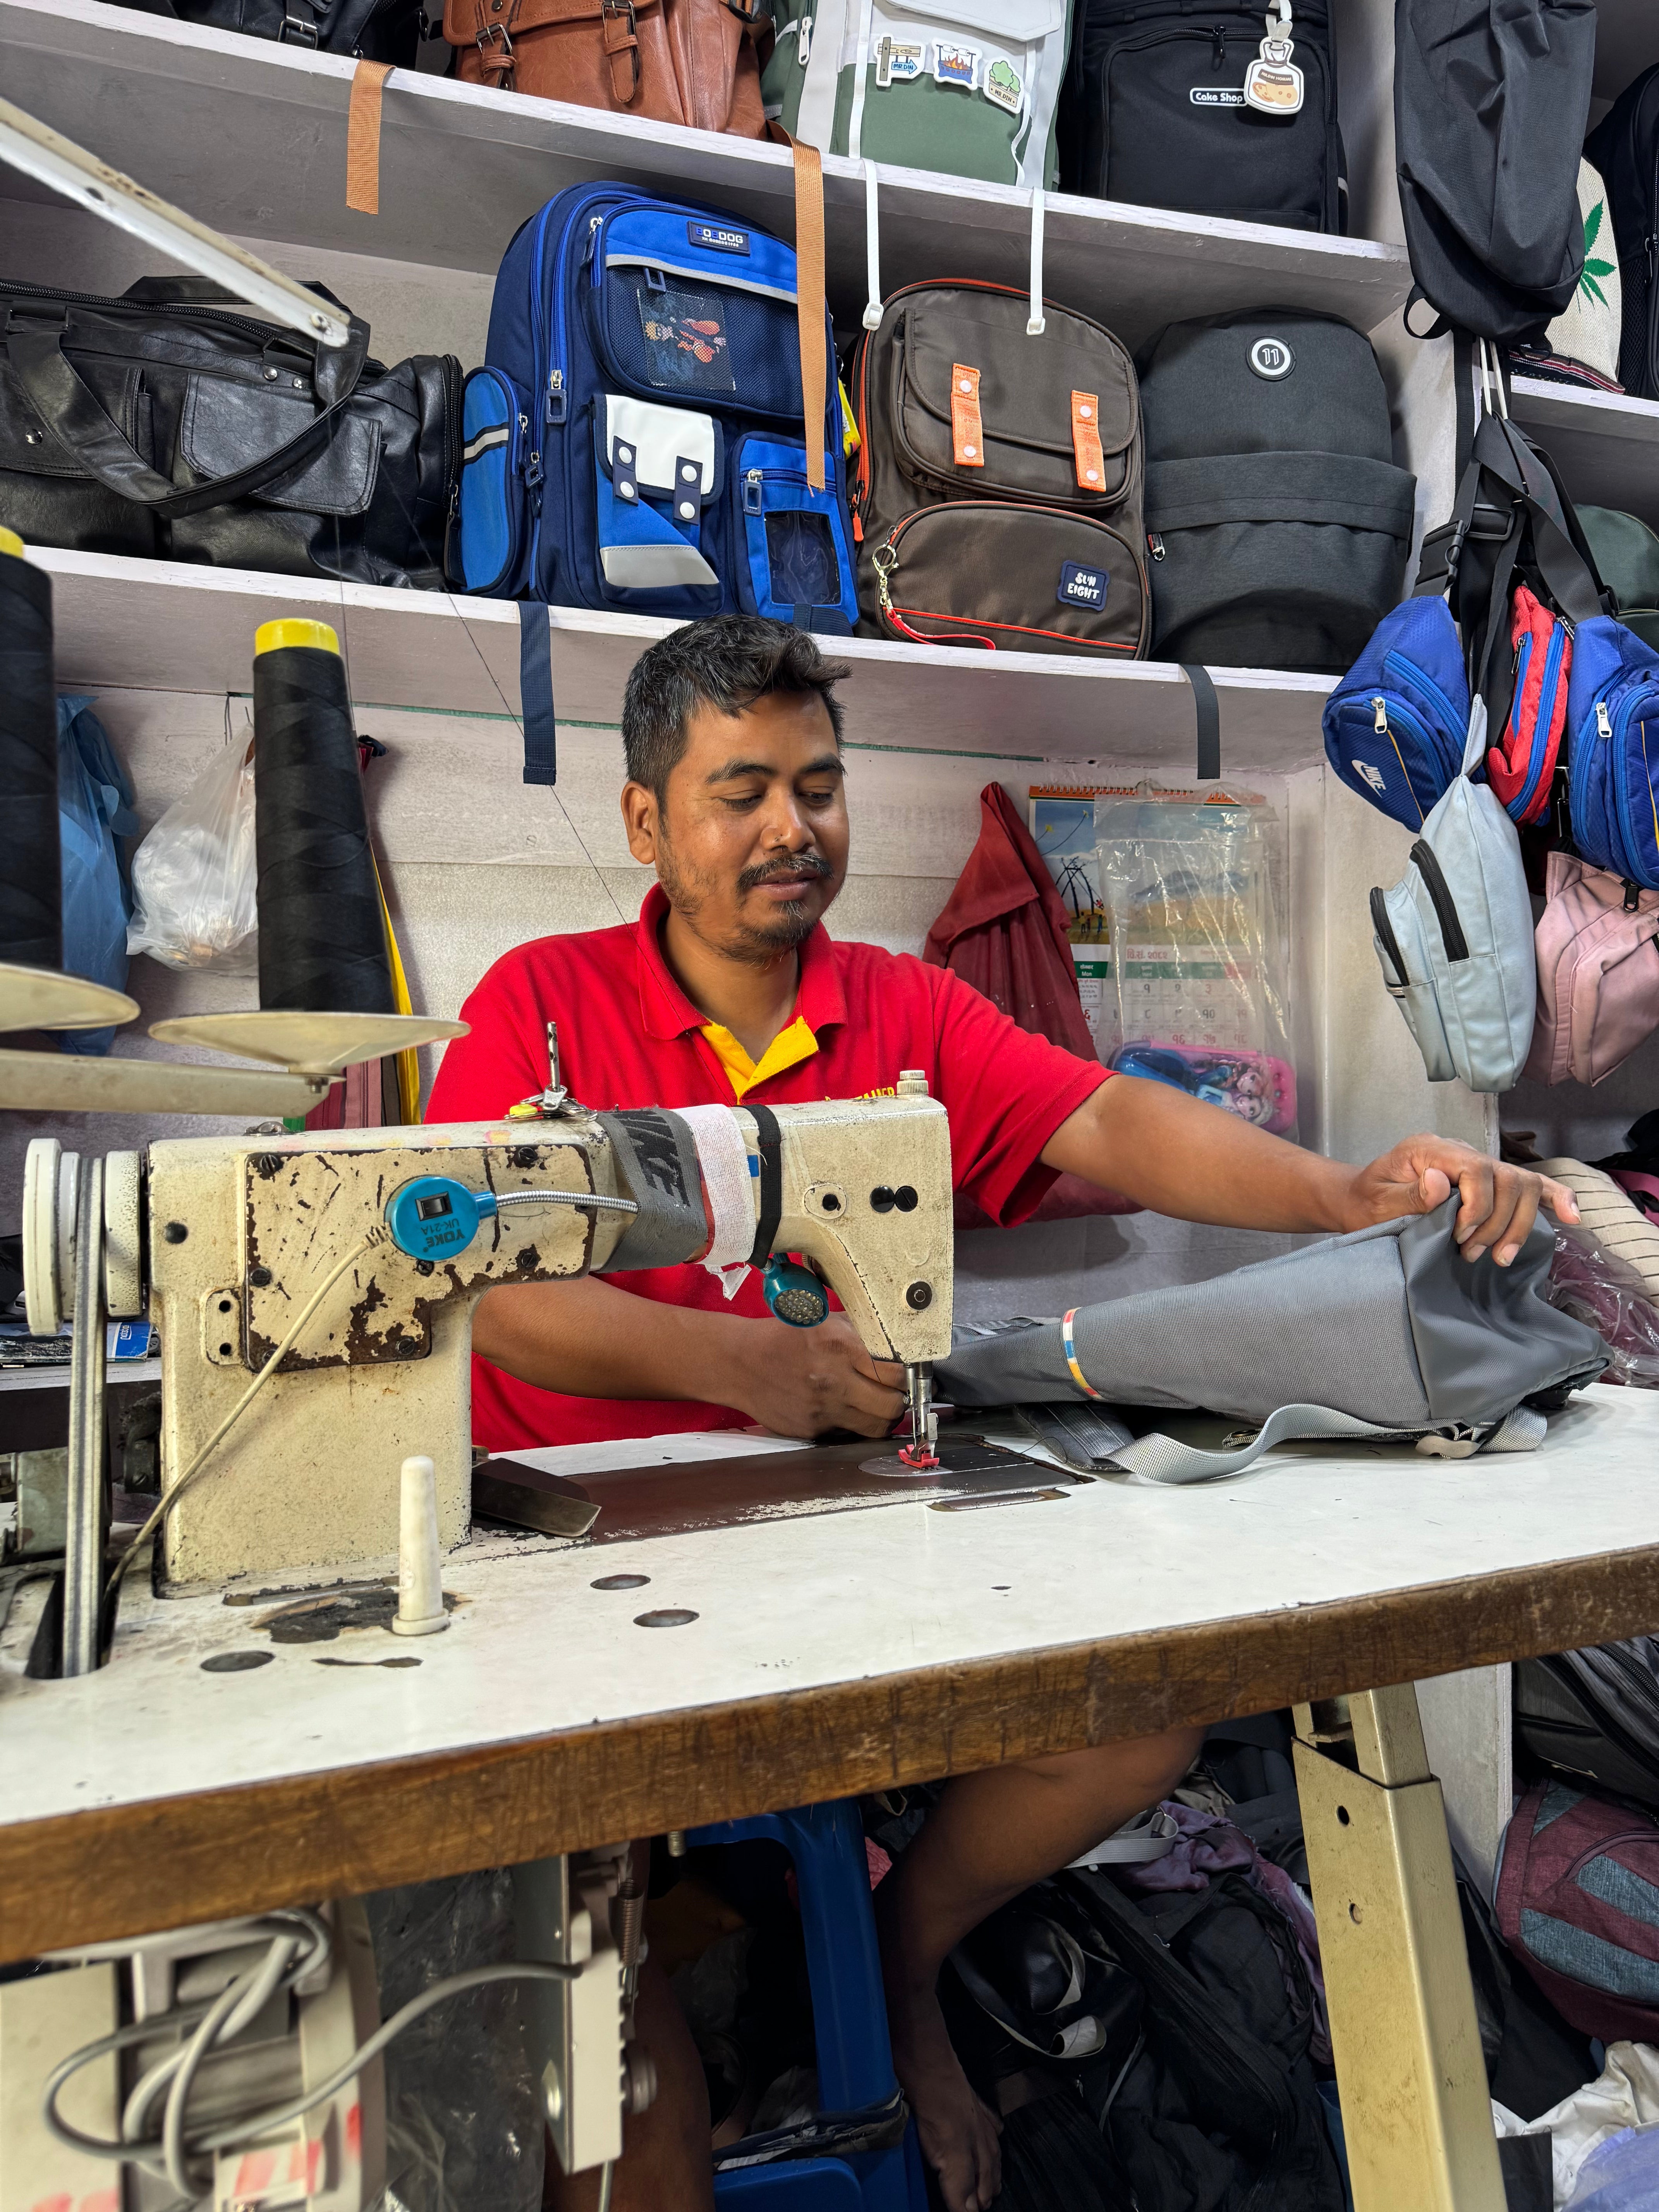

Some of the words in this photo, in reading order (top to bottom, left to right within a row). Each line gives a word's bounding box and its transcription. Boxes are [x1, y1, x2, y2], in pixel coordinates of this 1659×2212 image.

[1195, 92, 1218, 101] Cake
[1220, 93, 1243, 104] Shop
[696, 226, 743, 244] BOBDOG
[1075, 572, 1096, 587] SUN
[1067, 582, 1100, 599] EIGHT
[1363, 765, 1386, 790] NIKE
[421, 1218, 460, 1235] UK-21A
